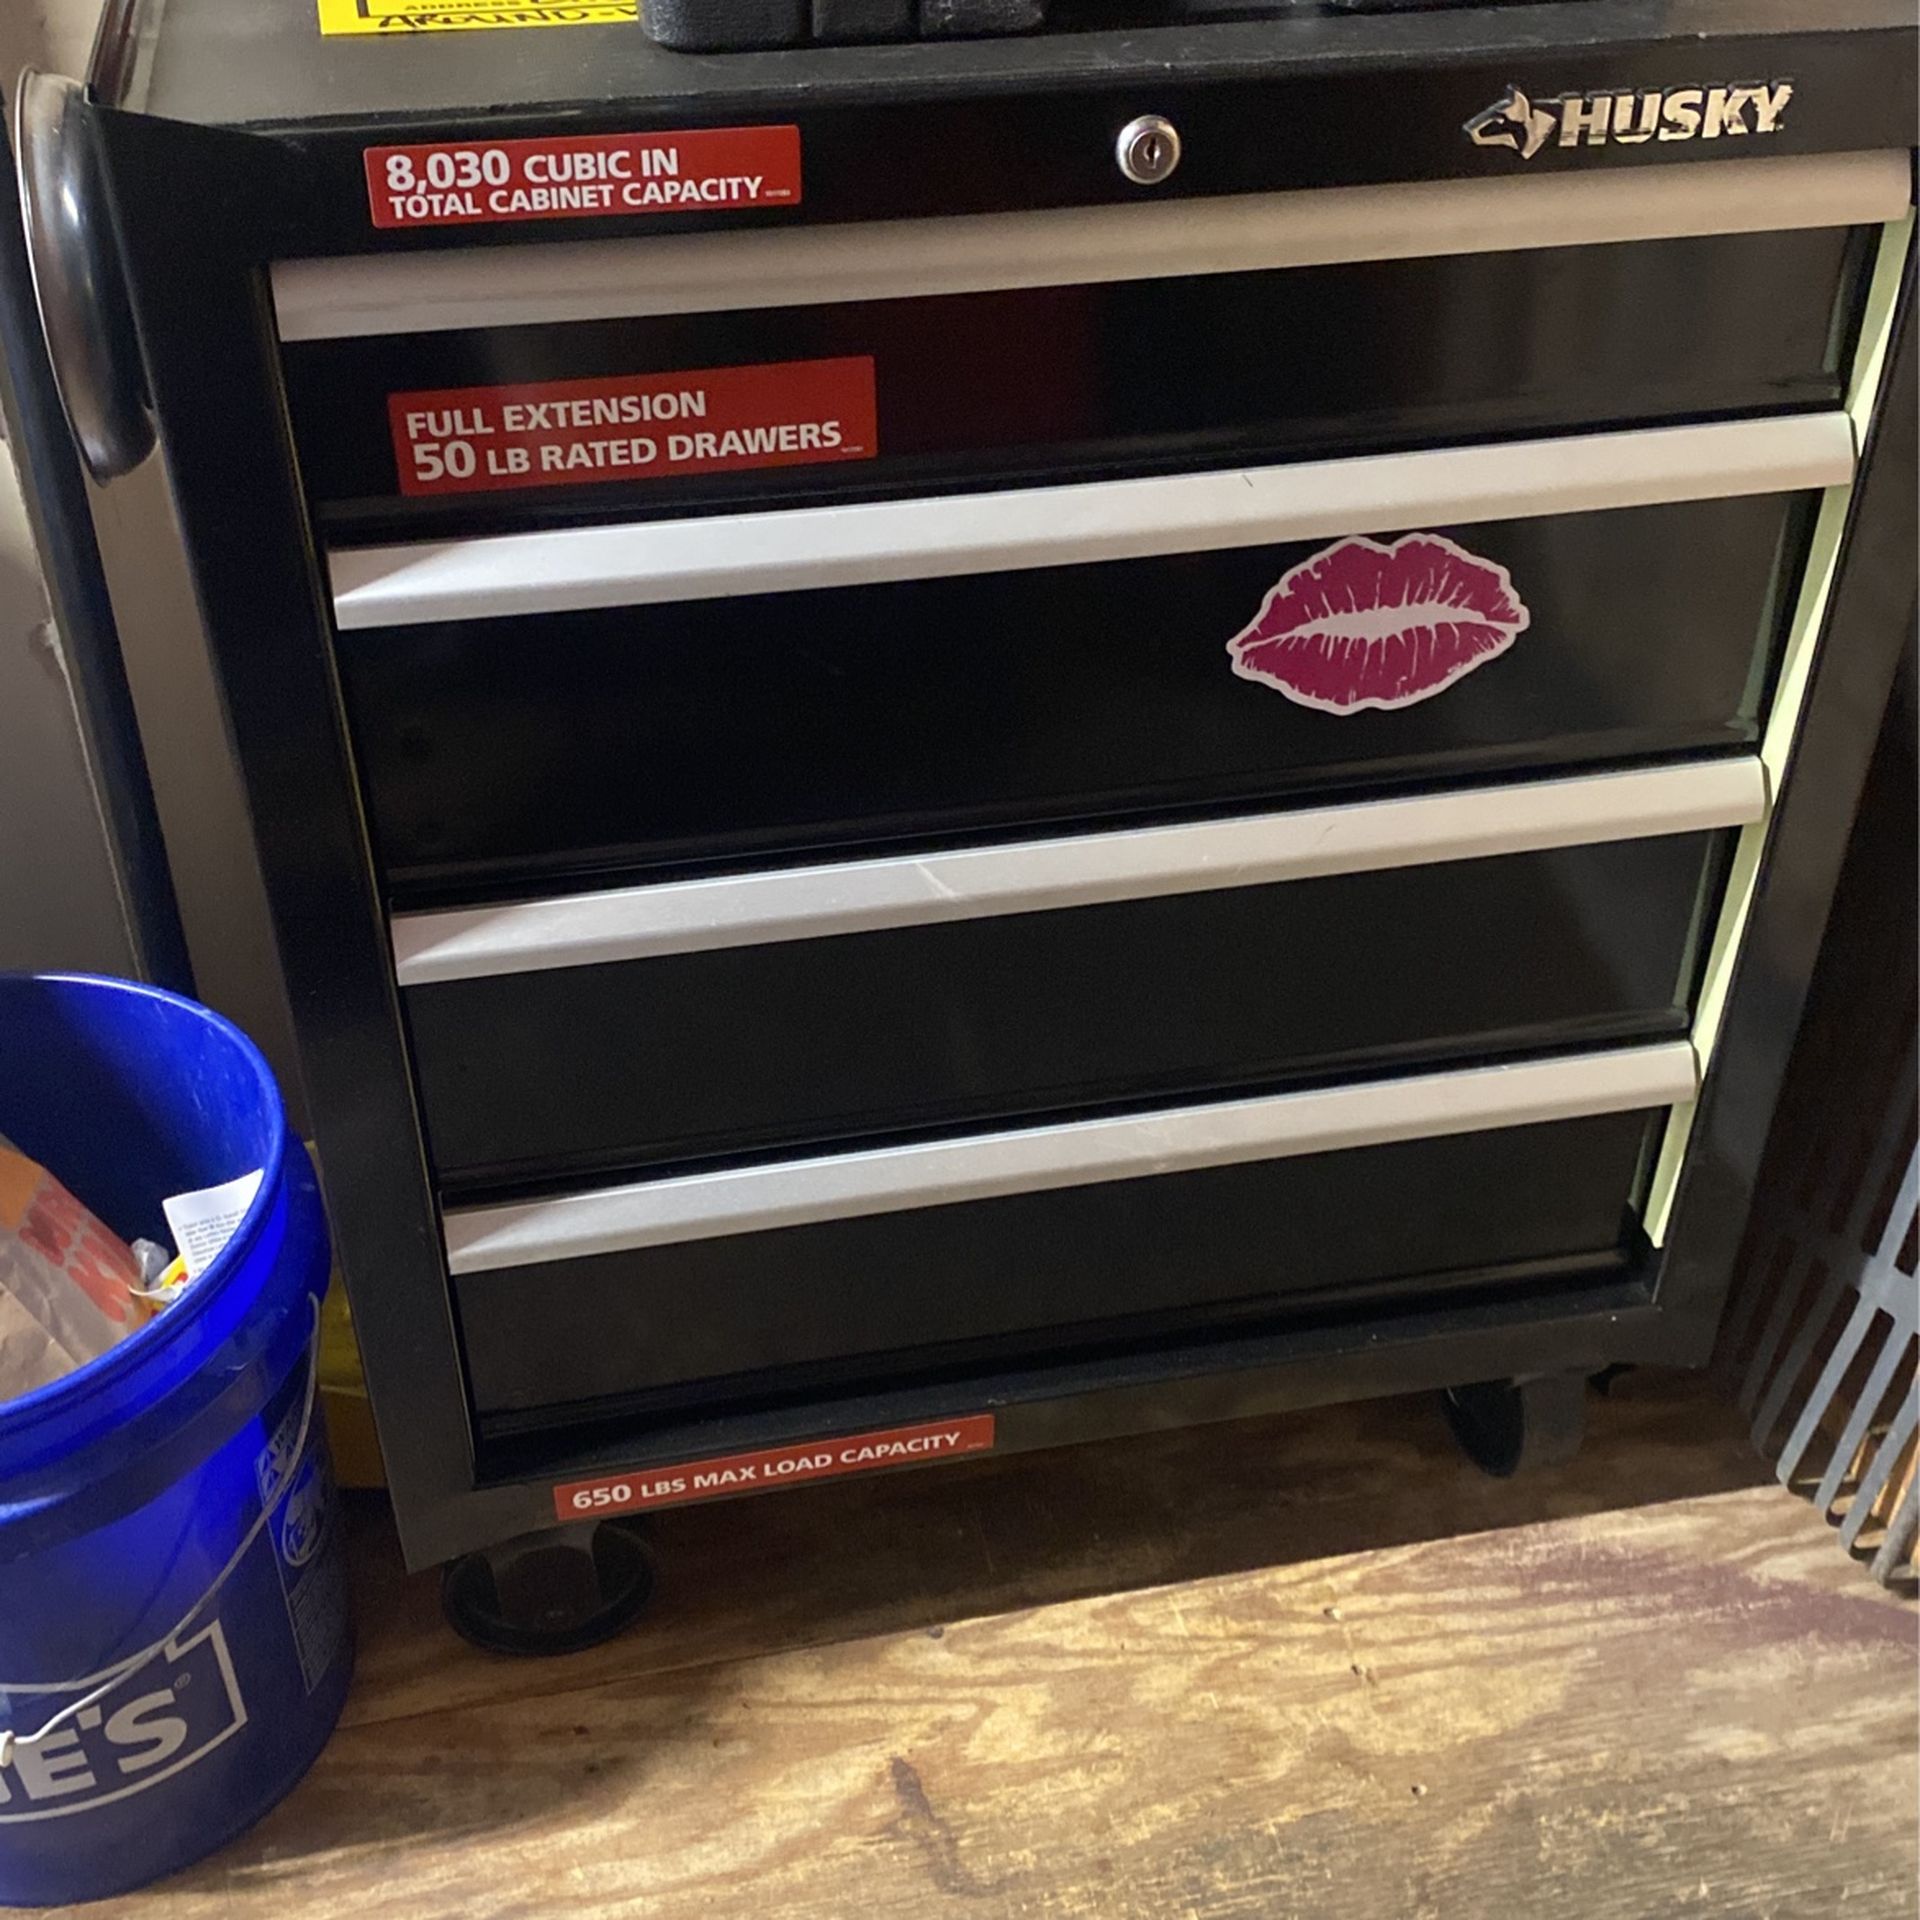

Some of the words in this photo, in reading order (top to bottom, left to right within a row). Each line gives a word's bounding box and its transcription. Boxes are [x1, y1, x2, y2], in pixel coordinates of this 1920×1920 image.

[1557, 80, 1795, 147] HUSKY
[386, 149, 511, 195] 8,030
[523, 150, 632, 183] CUBIC
[641, 147, 678, 177] IN
[388, 192, 483, 219] TOTAL
[488, 184, 615, 213] CABINET
[622, 176, 764, 206] CAPACITY
[406, 407, 495, 439] FULL
[503, 390, 706, 432] EXTENSION
[413, 440, 476, 481] 50
[487, 447, 531, 475] LB
[540, 438, 657, 471] RATED
[667, 421, 842, 461] DRAWERS
[572, 1484, 632, 1509] 650
[641, 1478, 686, 1498] LBS
[693, 1466, 757, 1489] MAX
[764, 1454, 833, 1477] LOAD
[840, 1431, 960, 1464] CAPACITY
[0, 1688, 188, 1804] E'S
